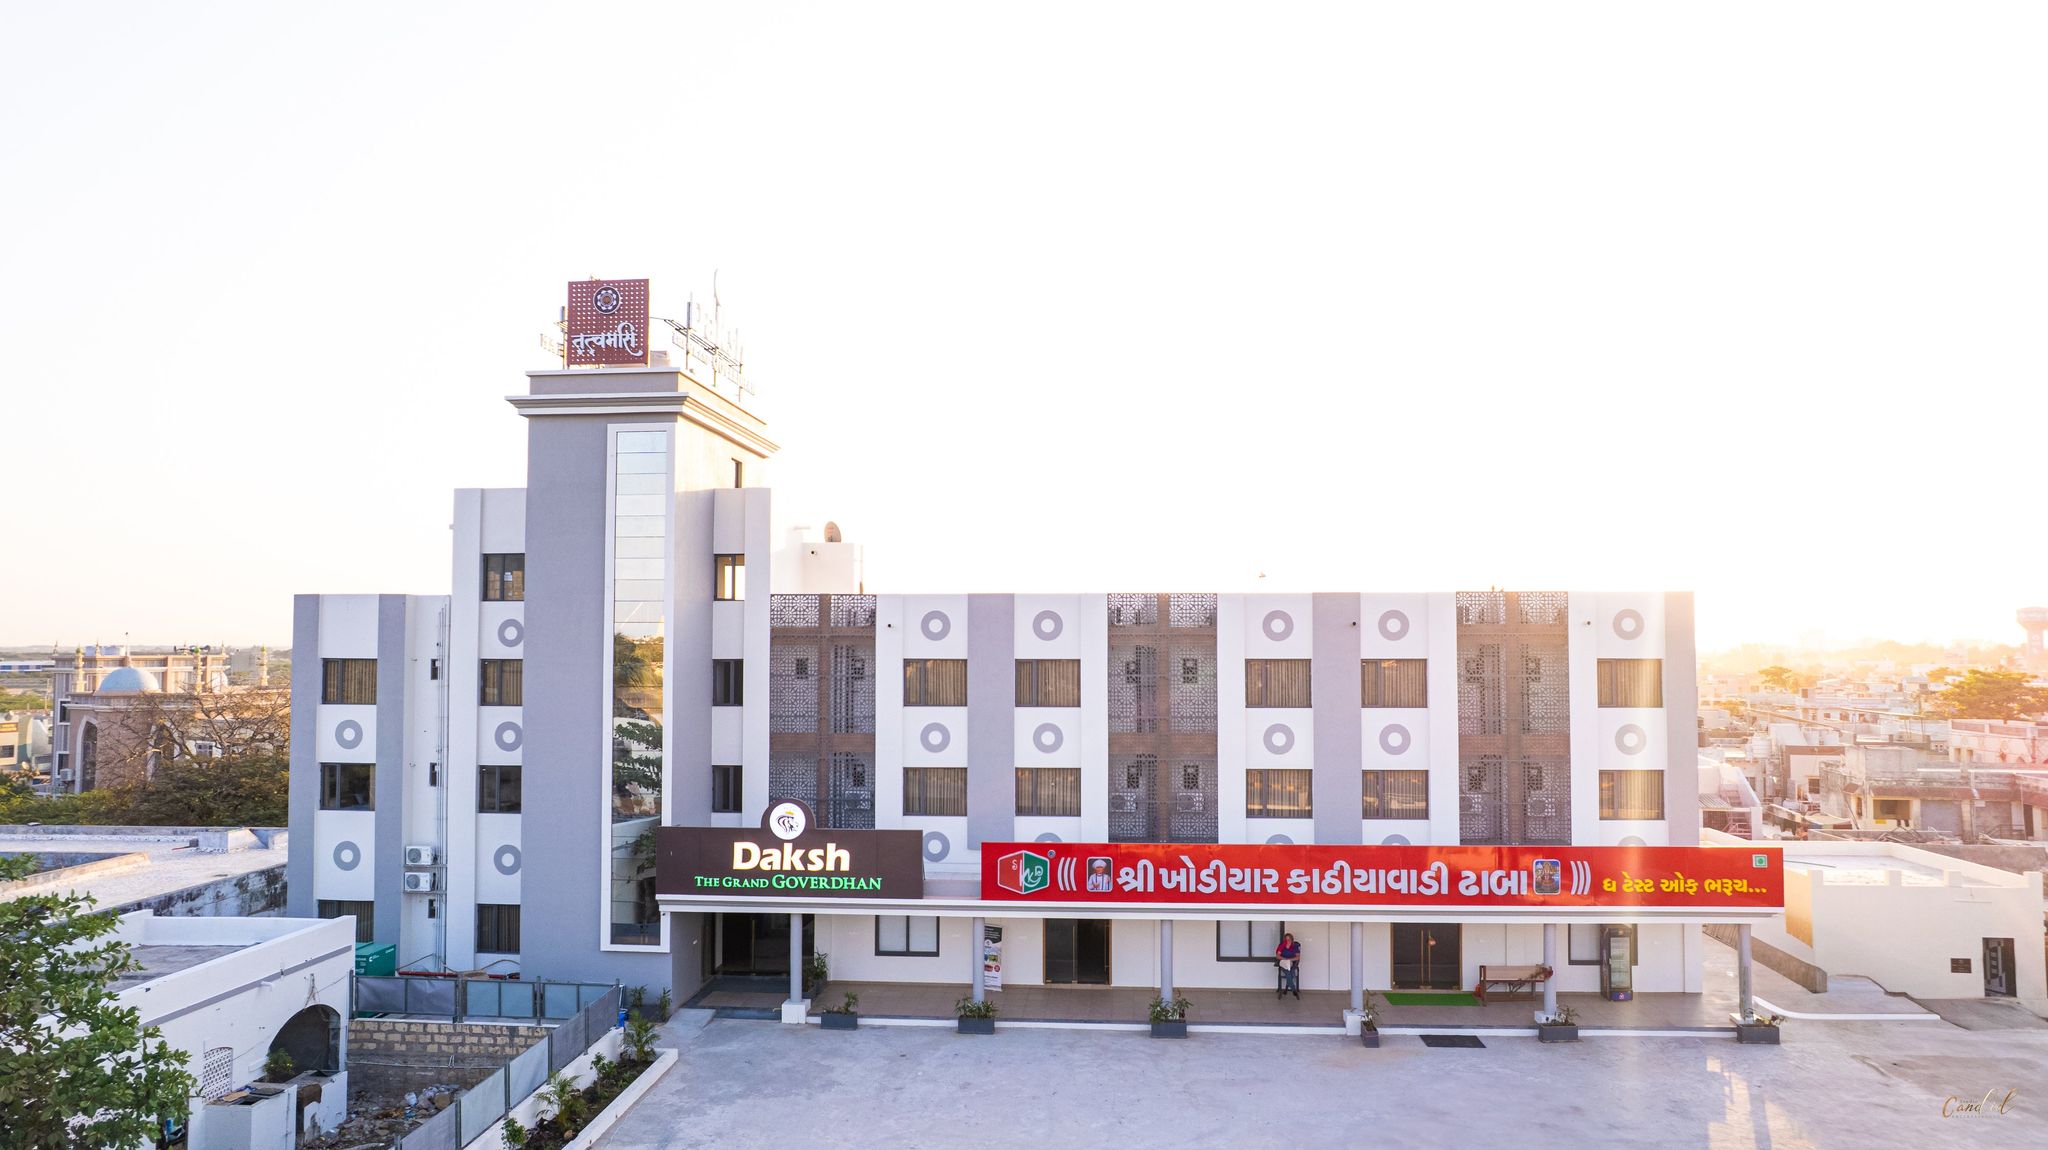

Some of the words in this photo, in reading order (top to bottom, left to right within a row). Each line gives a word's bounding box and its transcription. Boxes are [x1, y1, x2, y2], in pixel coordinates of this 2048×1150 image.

[733, 841, 850, 872] Daksh
[1116, 859, 1154, 892] શ્રી
[1159, 855, 1279, 894] ખોડીયાર
[1286, 860, 1449, 896] કાઠીયાવાડી
[1458, 870, 1528, 896] ઢાબા
[1622, 871, 1655, 893] ટેસ્ટ
[1660, 872, 1699, 896] ઓફ
